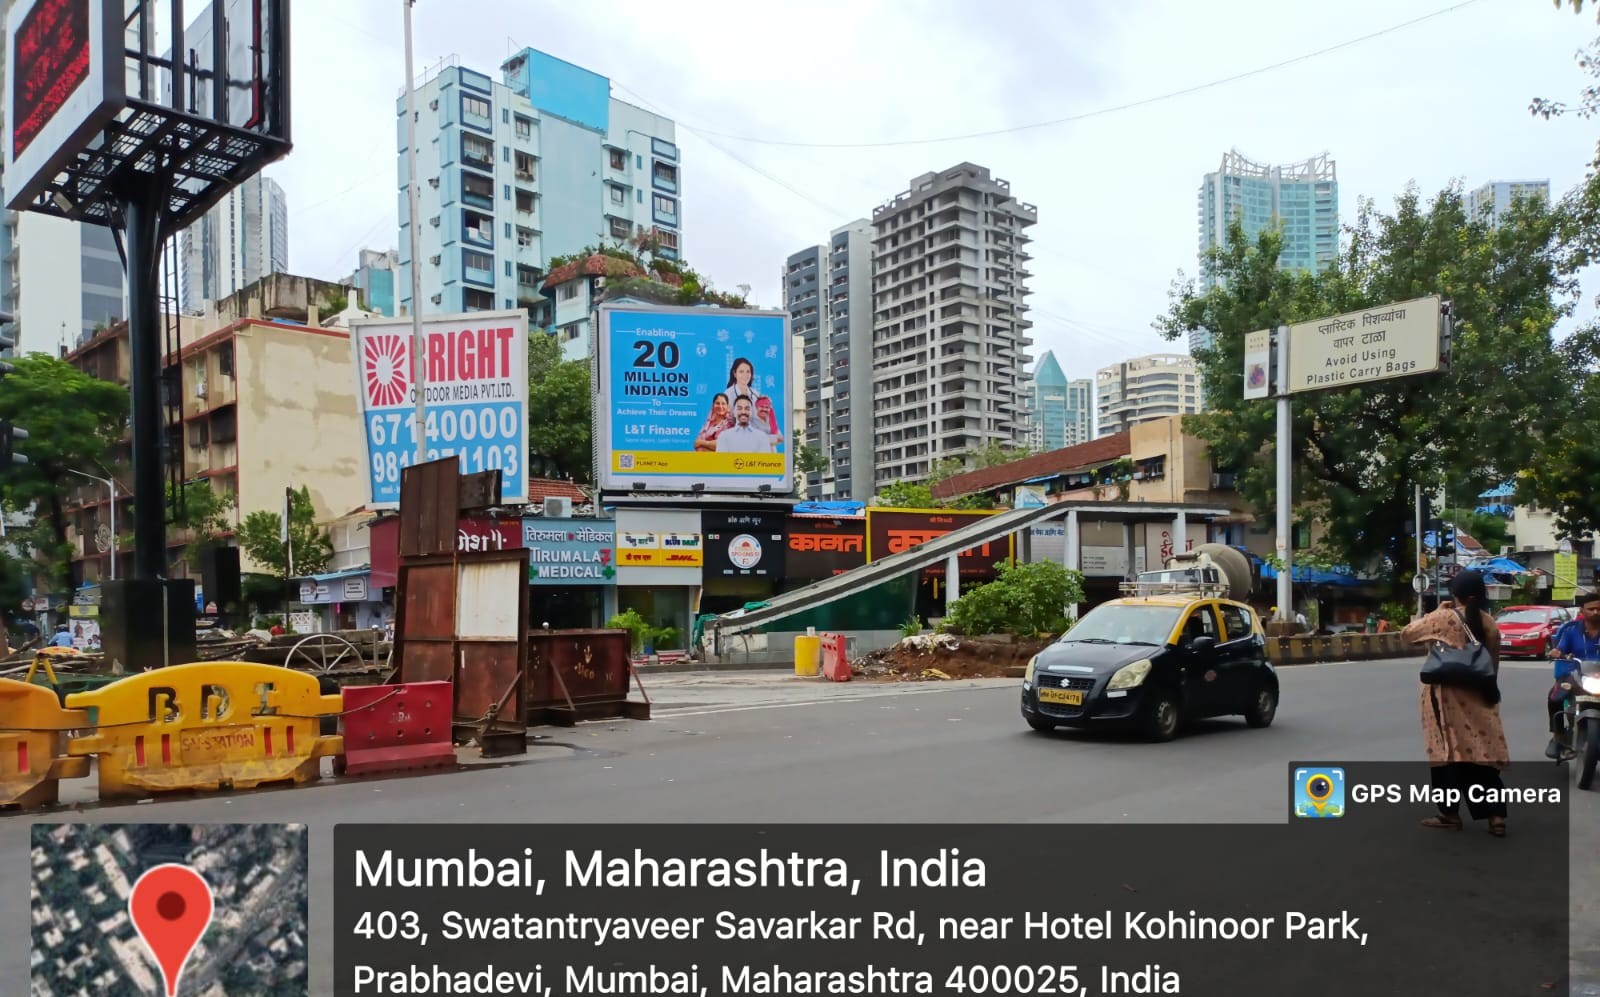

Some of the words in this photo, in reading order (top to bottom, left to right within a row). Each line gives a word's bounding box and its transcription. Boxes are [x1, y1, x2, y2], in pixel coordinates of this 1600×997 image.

[1318, 318, 1356, 335] प्लास्टिक
[1363, 308, 1406, 327] पिशव्यांचा
[636, 328, 676, 339] Enabling
[1333, 337, 1354, 349] वापर
[1361, 330, 1386, 344] टाळा
[633, 340, 680, 369] 20
[1326, 355, 1357, 367] Avoid
[1362, 348, 1396, 361] Using
[624, 371, 689, 384] MILLION
[1307, 368, 1345, 384] Plastic
[1350, 365, 1381, 379] Carry
[1386, 360, 1416, 373] Bags
[453, 384, 478, 401] MEDIA
[625, 385, 689, 397] INDIANS
[652, 399, 661, 407] To
[617, 408, 646, 416] Achieve
[648, 408, 667, 416] Their
[669, 409, 697, 417] Dreams
[625, 424, 646, 435] L&T
[649, 424, 690, 436] Finance
[526, 526, 567, 541] तिरुमला
[576, 526, 614, 542] मेडिकल
[789, 534, 864, 552] कामत
[529, 547, 602, 562] TIRUMALA
[539, 566, 603, 578] MEDICAL
